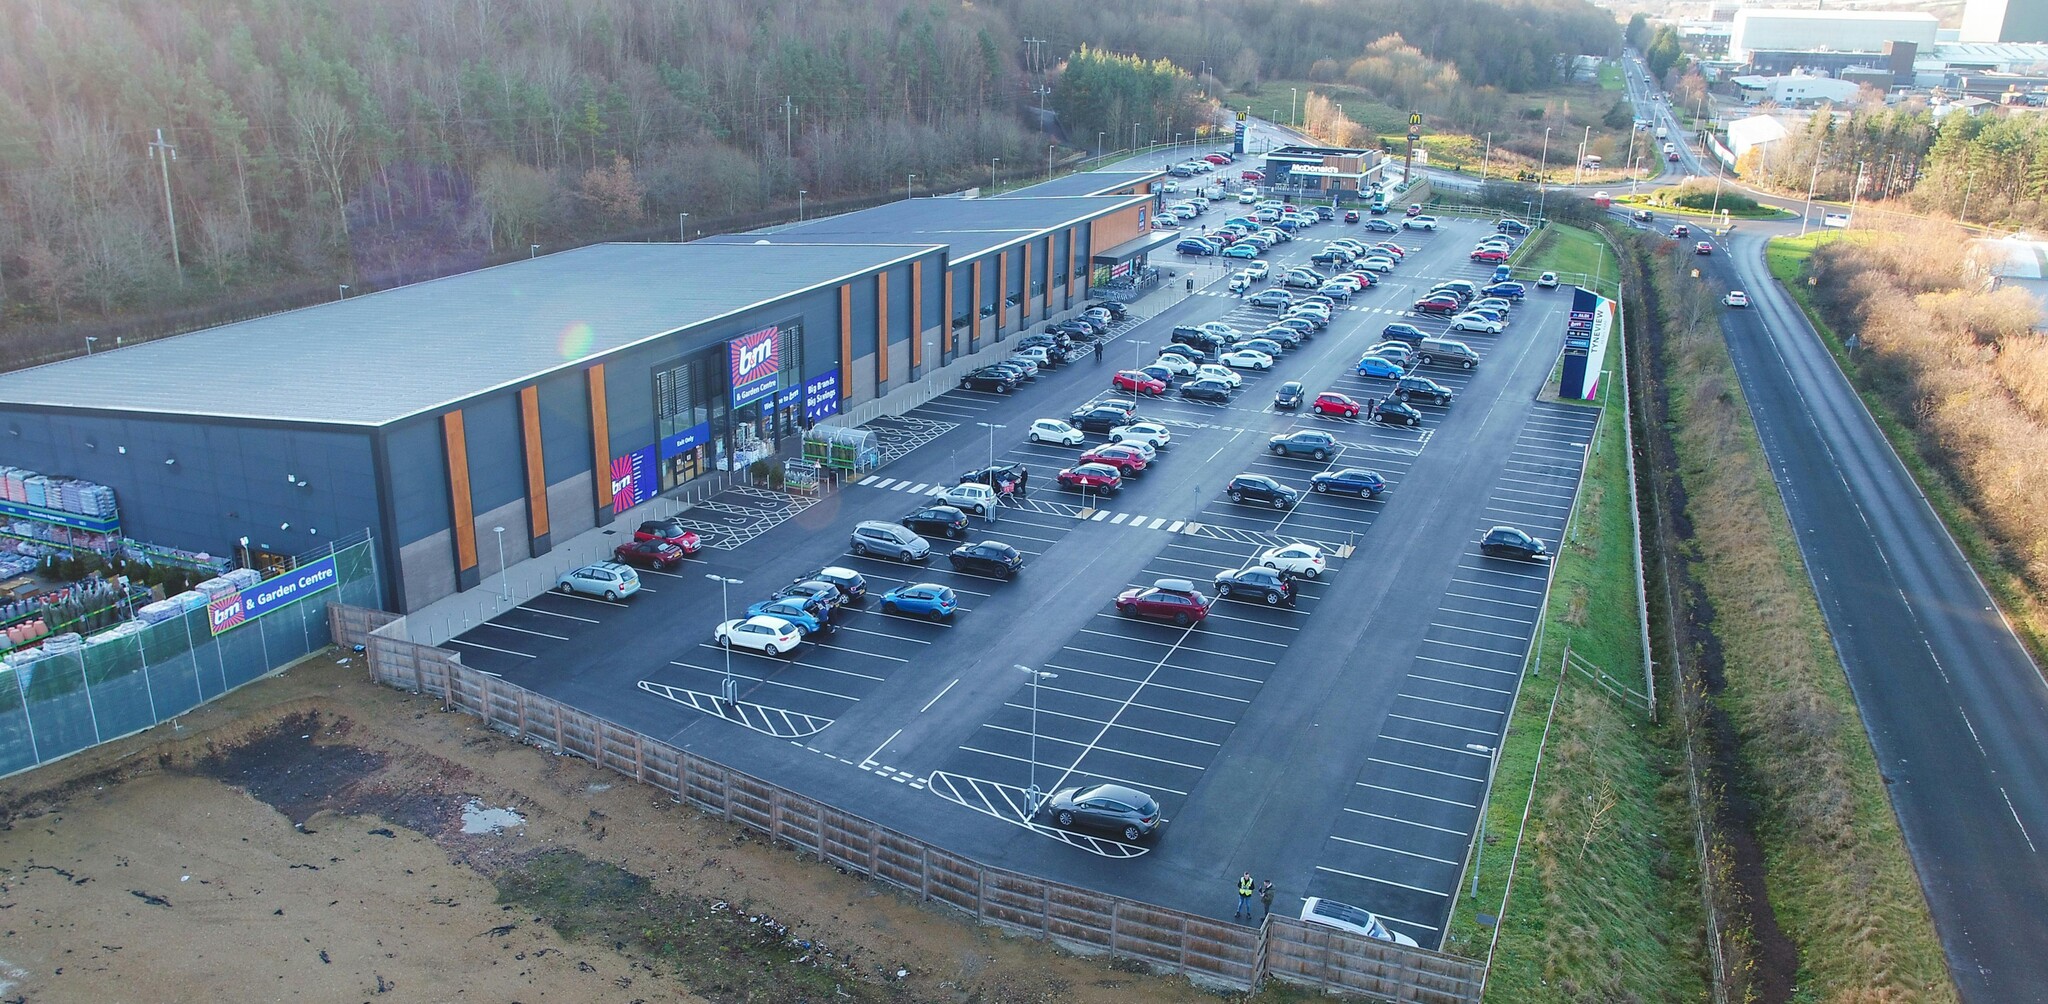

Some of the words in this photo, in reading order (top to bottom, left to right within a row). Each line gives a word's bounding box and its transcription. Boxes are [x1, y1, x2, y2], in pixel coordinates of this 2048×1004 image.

[1291, 164, 1339, 173] McDonald's
[1591, 310, 1604, 353] TYNEVIEW
[741, 387, 760, 399] Garden
[760, 380, 777, 391] Centre
[807, 384, 817, 394] Big
[817, 376, 835, 391] Brands
[807, 396, 817, 407] Big
[816, 389, 836, 403] Savings
[676, 439, 685, 447] Exit
[685, 436, 694, 444] Only
[246, 598, 255, 610] &
[257, 582, 297, 605] Garden
[298, 568, 333, 588] Centre
